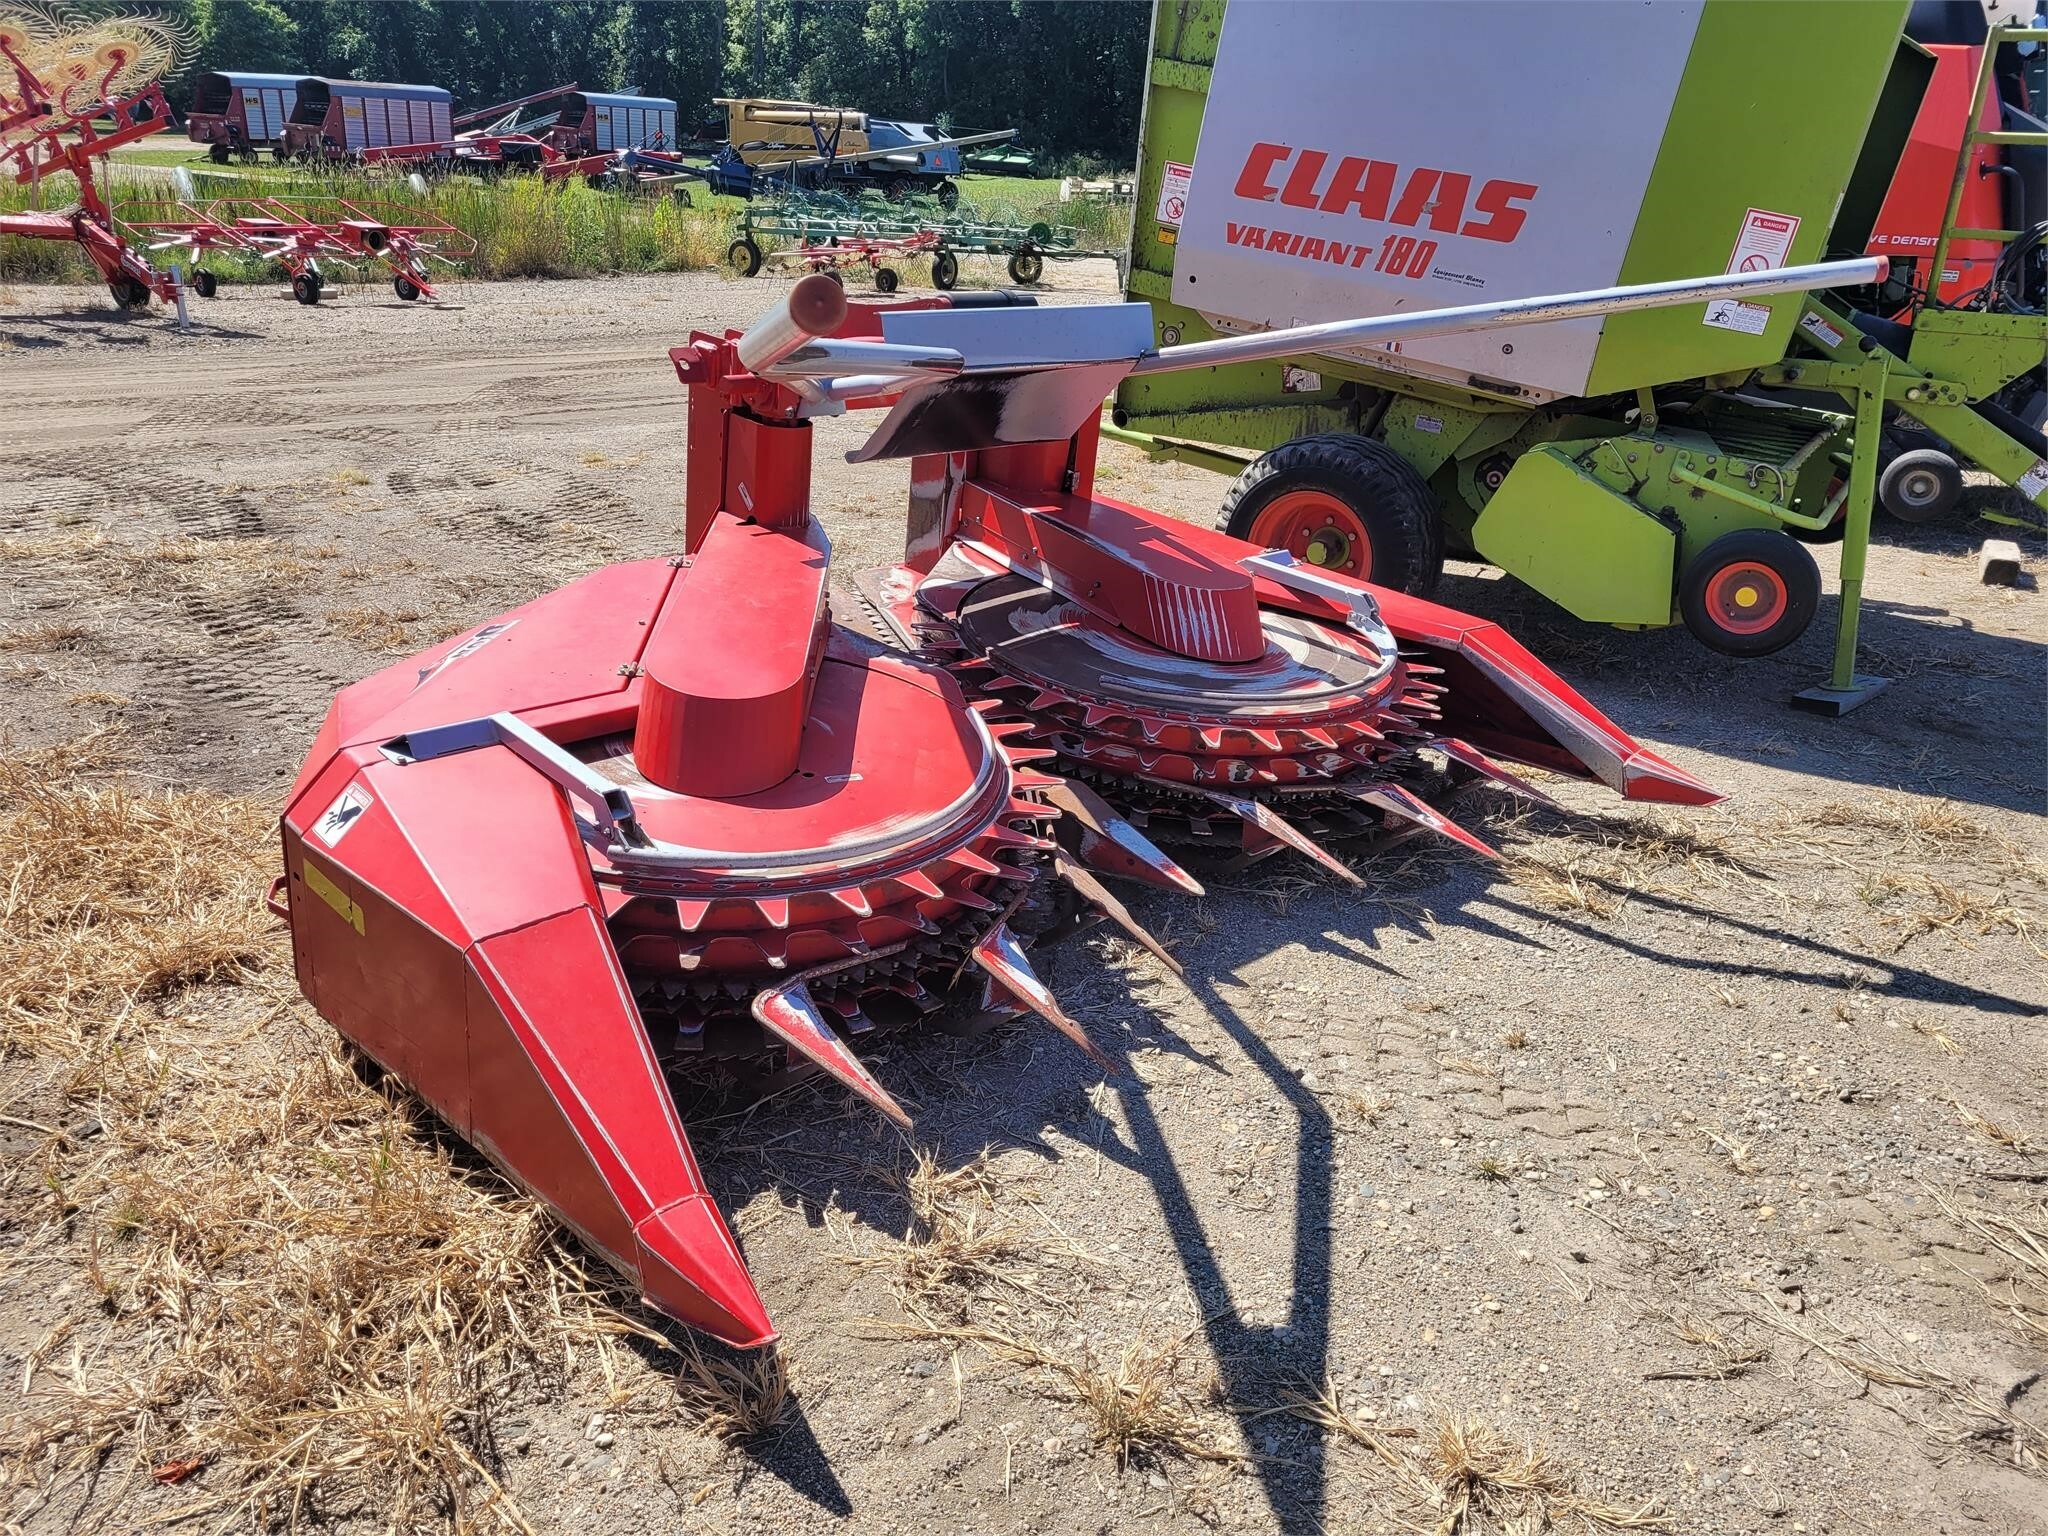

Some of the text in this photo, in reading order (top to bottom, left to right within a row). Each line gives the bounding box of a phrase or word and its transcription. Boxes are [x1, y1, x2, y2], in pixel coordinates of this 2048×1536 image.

[1233, 142, 1539, 243] CLAAS
[1763, 221, 1787, 230] DANGER
[1891, 235, 1940, 247] DENSIT
[1226, 222, 1438, 280] VARIANT 180
